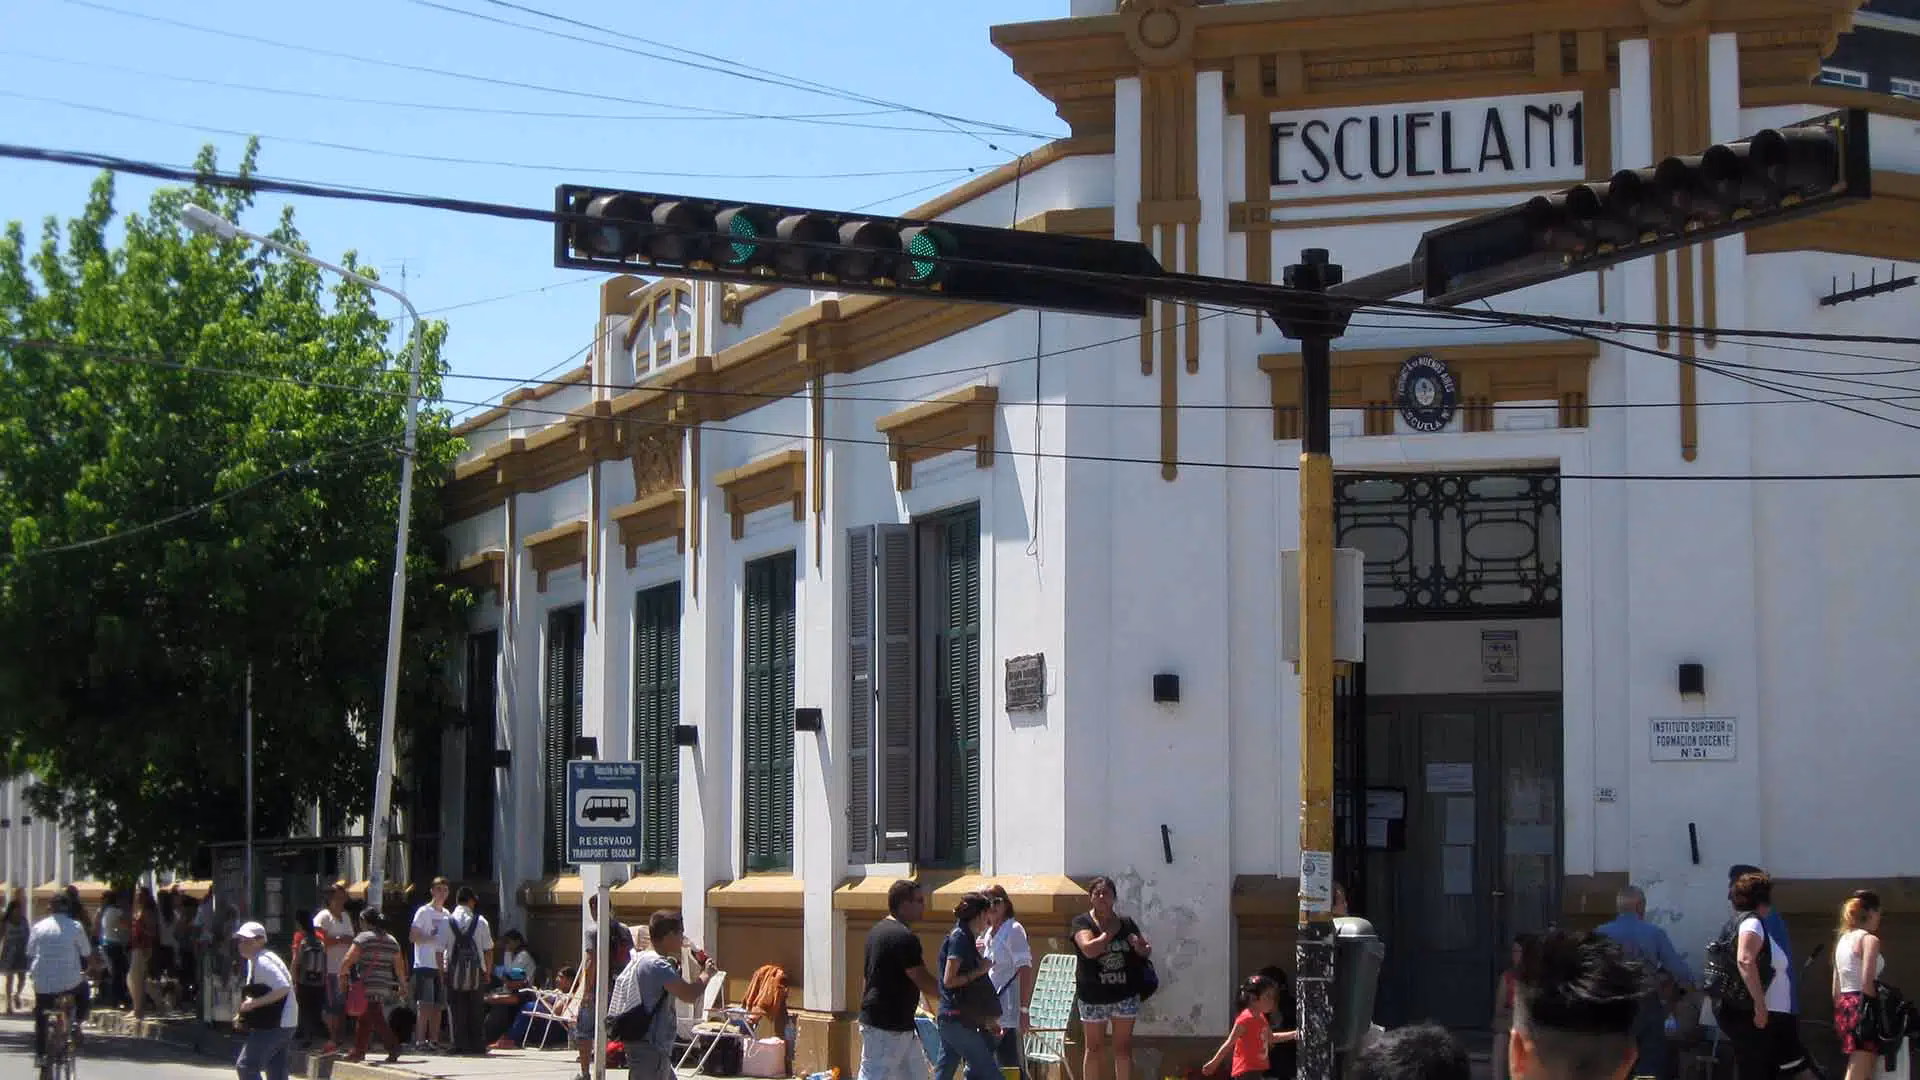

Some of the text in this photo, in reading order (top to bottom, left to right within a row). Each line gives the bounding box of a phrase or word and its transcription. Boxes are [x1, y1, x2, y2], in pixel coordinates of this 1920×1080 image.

[1271, 107, 1514, 185] ESCUELA
[1652, 721, 1689, 733] INSTITUTO
[1691, 720, 1725, 732] SUPERIOR
[1699, 734, 1731, 746] DOCENTE
[579, 836, 632, 846] RESERVADO
[572, 848, 637, 858] TRANSPORTE ESCOLAR
[1098, 972, 1127, 985] YOU
